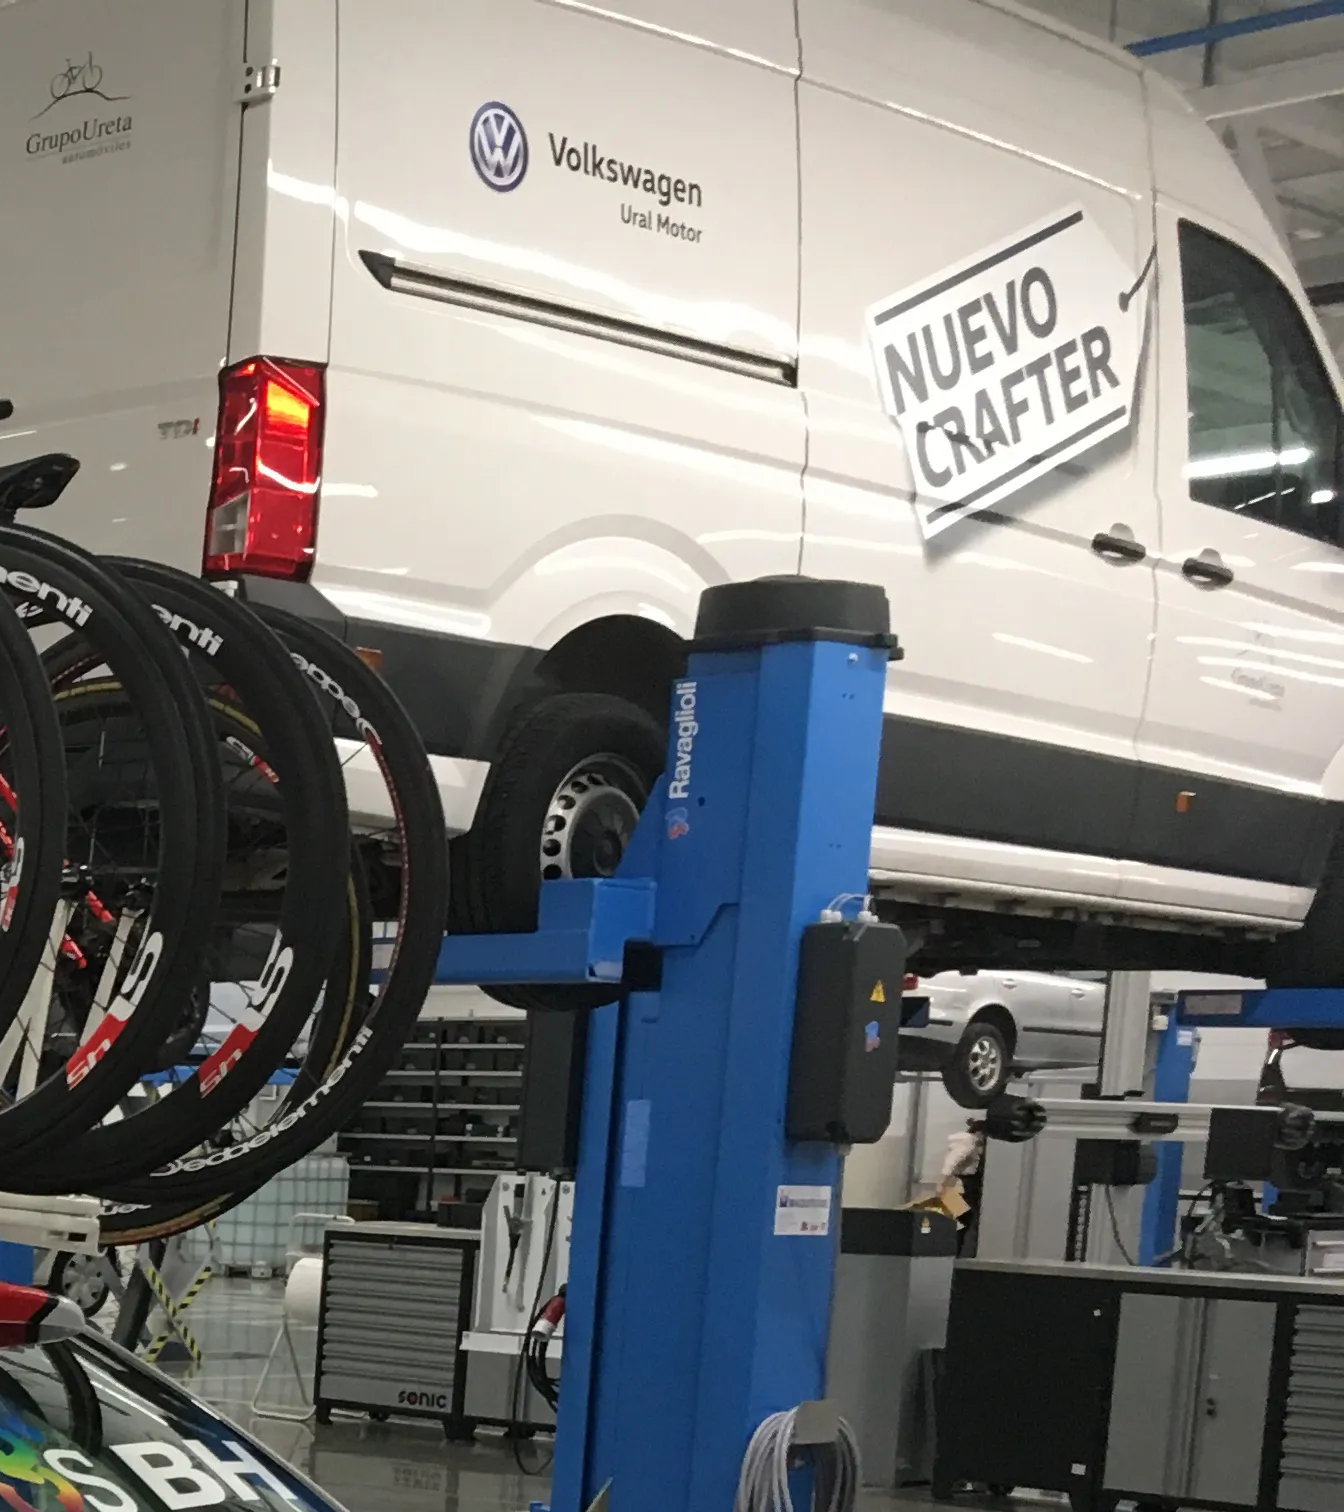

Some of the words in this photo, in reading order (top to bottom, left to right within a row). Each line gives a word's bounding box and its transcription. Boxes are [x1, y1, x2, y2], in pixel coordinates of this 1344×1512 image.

[25, 114, 133, 155] GrupoUreta
[548, 132, 702, 207] Volkswagen
[620, 203, 653, 231] Ural
[656, 213, 703, 244] Motor
[882, 265, 1059, 418] NUEVO
[913, 324, 1120, 490] CRAFTER
[668, 681, 699, 800] Ravaglioli
[109, 1438, 300, 1512] BH
